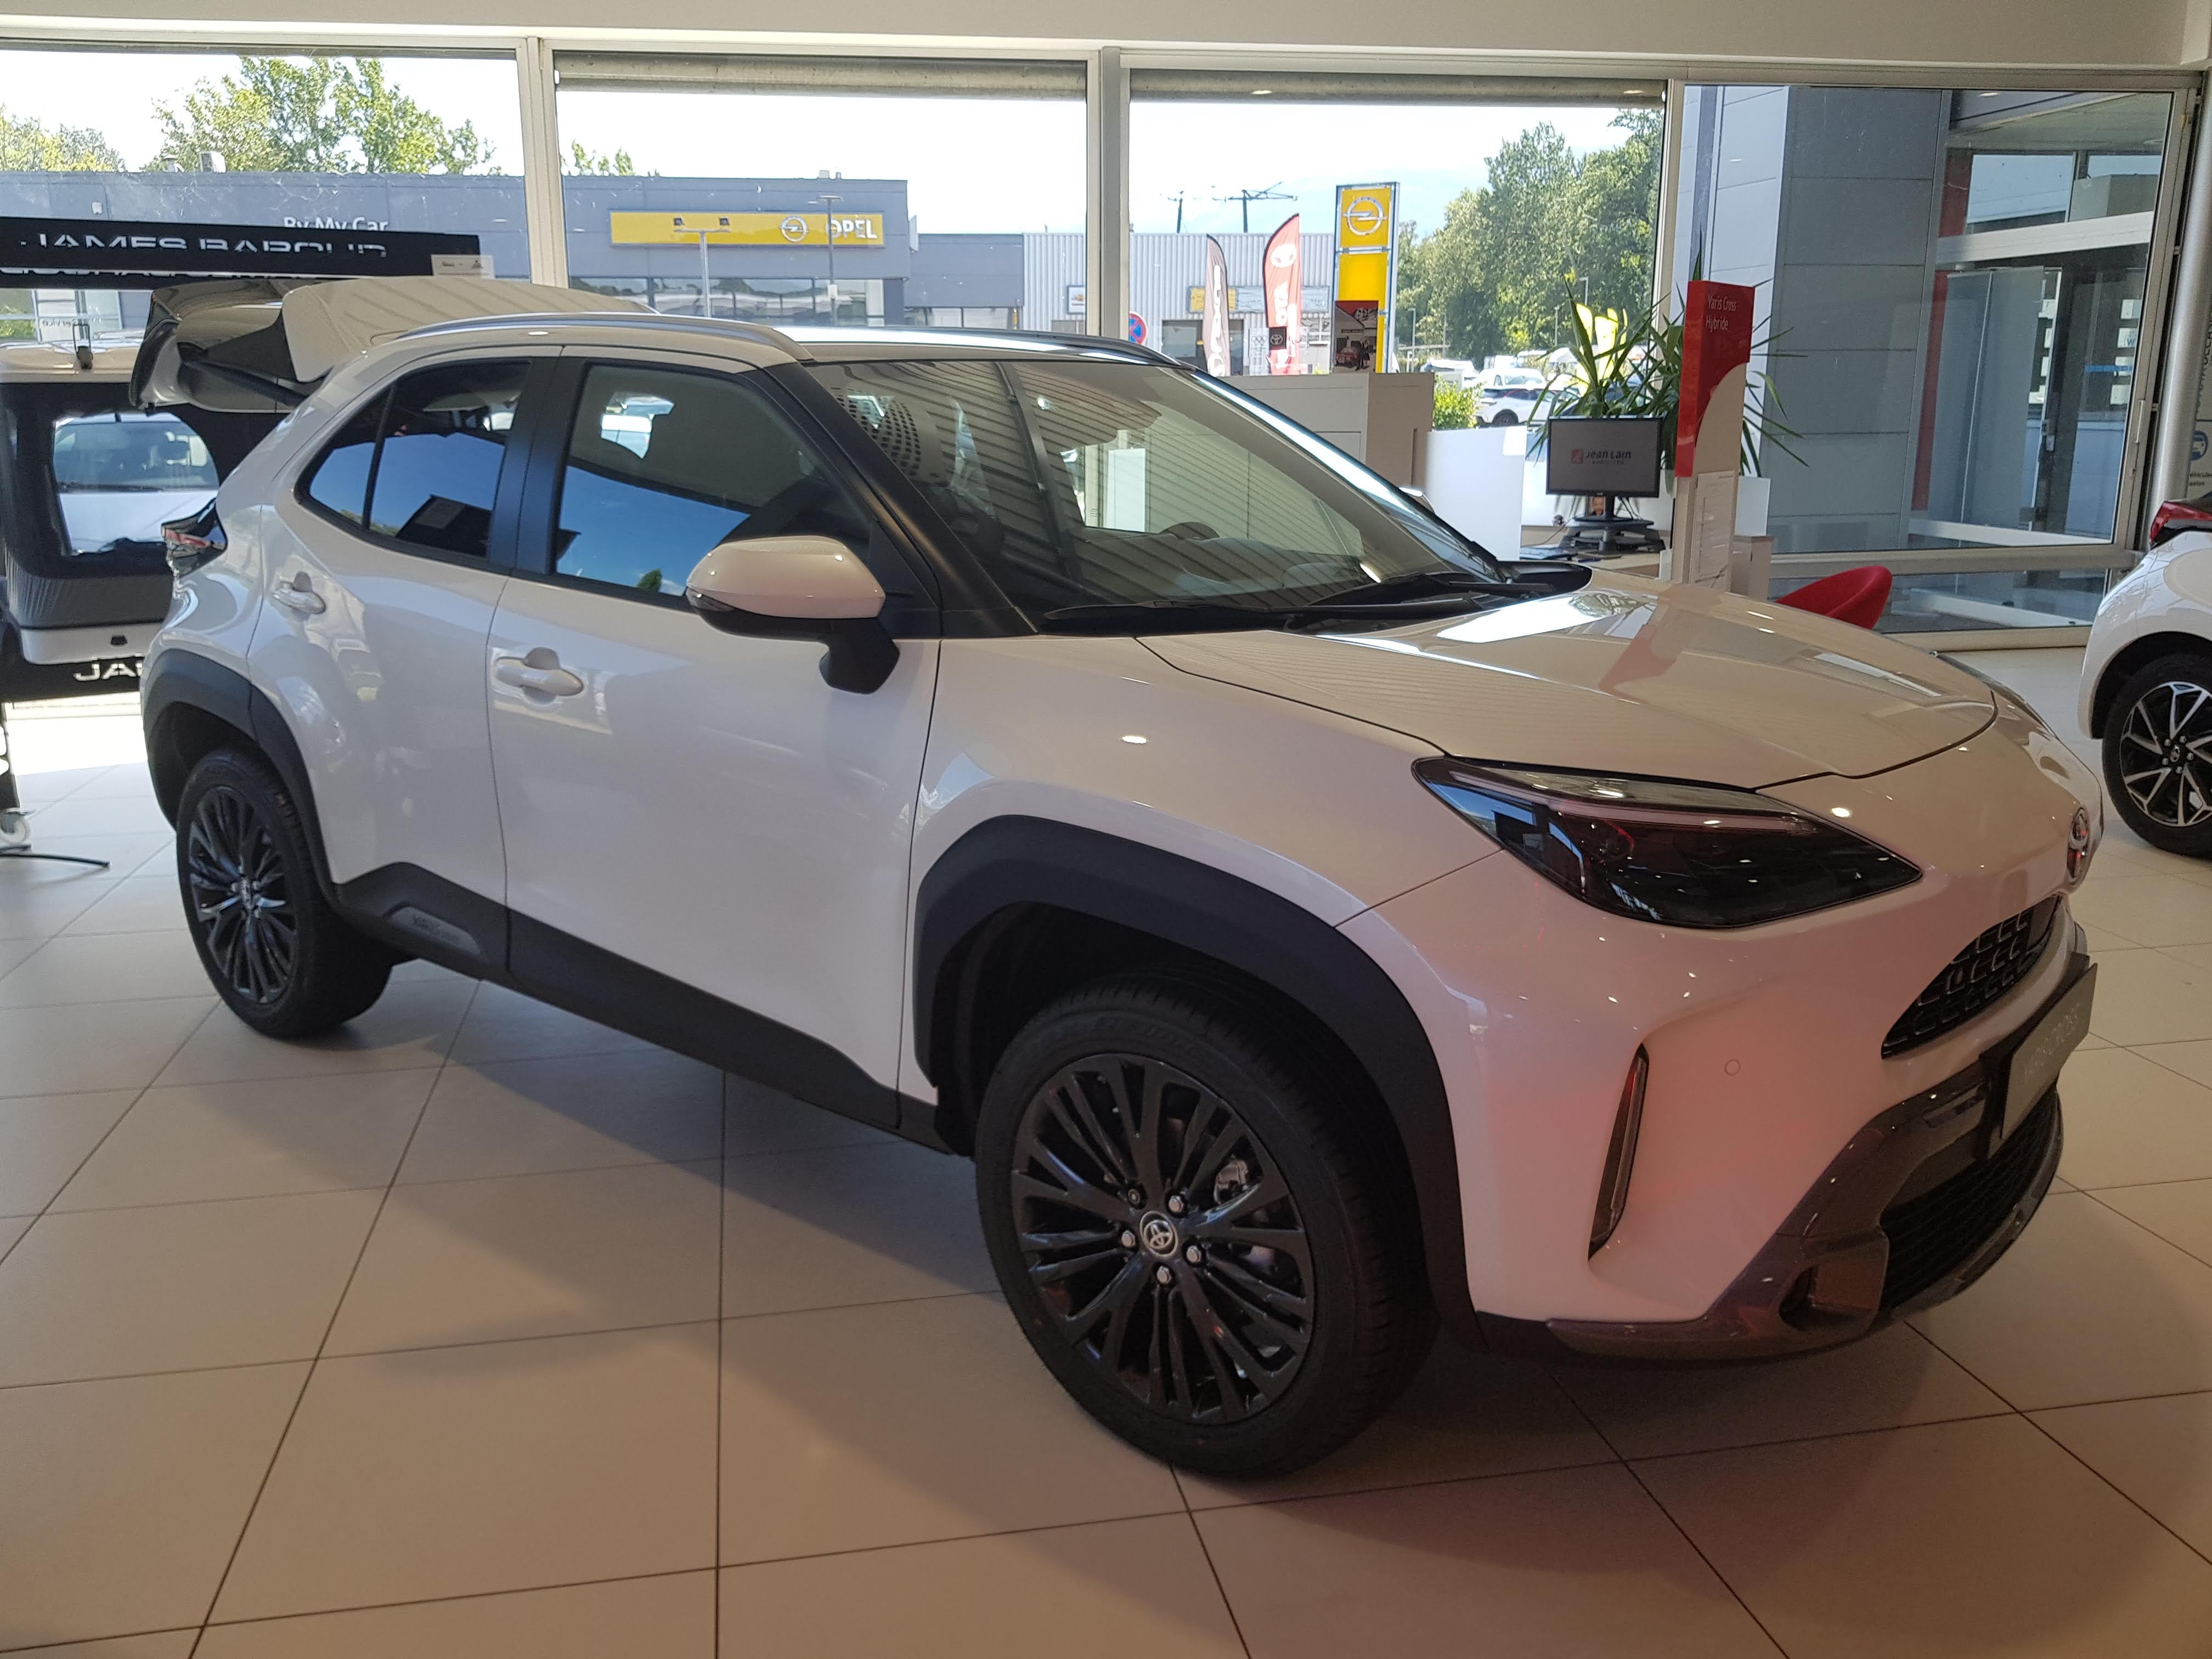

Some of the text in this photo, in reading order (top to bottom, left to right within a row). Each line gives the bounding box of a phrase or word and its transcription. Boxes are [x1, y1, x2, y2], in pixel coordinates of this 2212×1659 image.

[352, 216, 390, 231] Car
[825, 219, 878, 238] OPEL
[1707, 295, 1737, 312] Yaris Cross
[1705, 314, 1729, 333] Hybride
[1585, 450, 1609, 460] Jean
